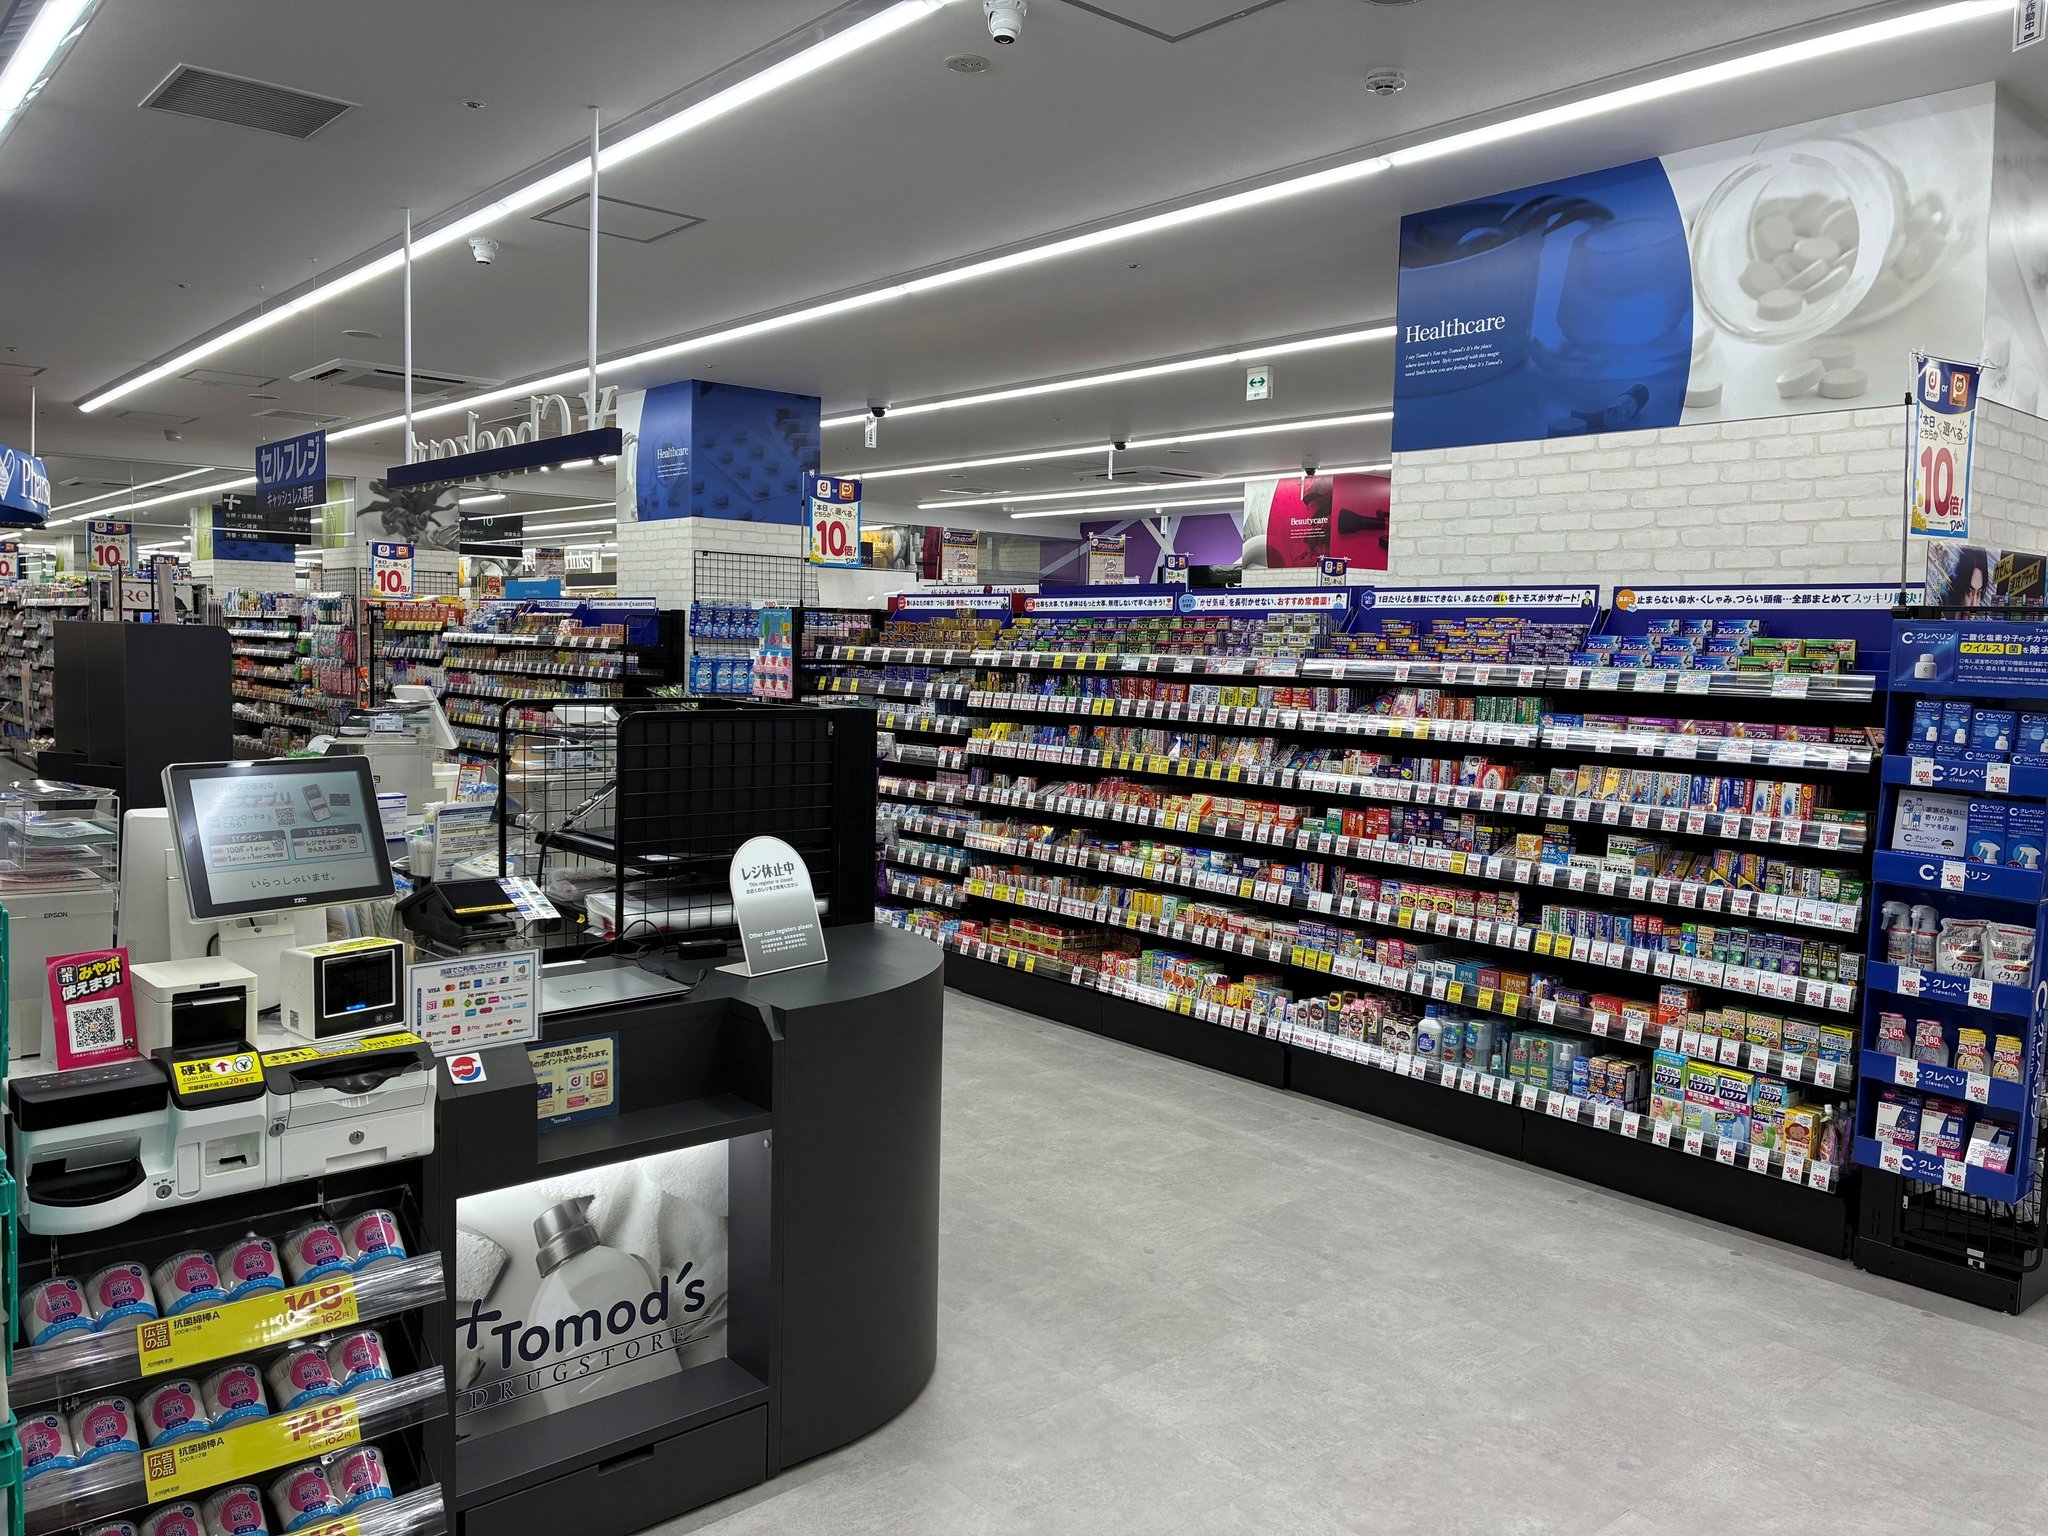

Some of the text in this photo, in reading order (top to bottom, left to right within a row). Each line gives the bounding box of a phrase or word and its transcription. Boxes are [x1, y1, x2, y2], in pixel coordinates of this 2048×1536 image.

[1405, 315, 1505, 343] Healthcare
[1941, 384, 1949, 393] or
[1922, 415, 1936, 429] 本日
[1919, 429, 1939, 442] どちらか
[1942, 421, 1963, 442] 選べる
[261, 436, 320, 484] セルフレジ
[657, 446, 689, 460] Healthcare
[1920, 446, 1954, 517] 10
[267, 485, 314, 508] キャッシュレス専用
[1290, 517, 1329, 526] Beautycare
[816, 520, 846, 557] 10
[95, 545, 120, 567] 10
[377, 569, 402, 593] 10
[1916, 632, 1954, 640] クレベリン
[1963, 643, 2002, 653] ウイルス
[742, 861, 795, 881] レジ休止中
[250, 872, 336, 889] いらっしゃいませ。
[776, 926, 797, 935] registers
[78, 956, 122, 981] みやポ
[61, 972, 122, 1001] 使えます!
[1932, 989, 1957, 997] cleverin
[537, 1046, 588, 1060] 一度のお買い物で
[180, 1063, 212, 1077] 硬貨
[1656, 1065, 1680, 1077] 鼻うがい
[183, 1074, 199, 1082] coin
[1656, 1074, 1680, 1085] ハナノア
[1692, 1074, 1714, 1085] 鼻うがい
[1722, 1079, 1747, 1091] 鼻うがい
[1925, 1080, 1950, 1089] cleverin
[1690, 1081, 1715, 1093] ハナノア
[1761, 1085, 1782, 1094] 鼻うがい
[1721, 1089, 1747, 1101] ハナノア
[1760, 1092, 1781, 1101] ハナノア
[1812, 1174, 1827, 1184] 338
[173, 1312, 221, 1329] 抗菌綿棒A
[491, 1262, 705, 1369] Tomod's
[470, 1327, 686, 1411] DRUGSTORE
[178, 1437, 225, 1457] 抗菌綿棒A
